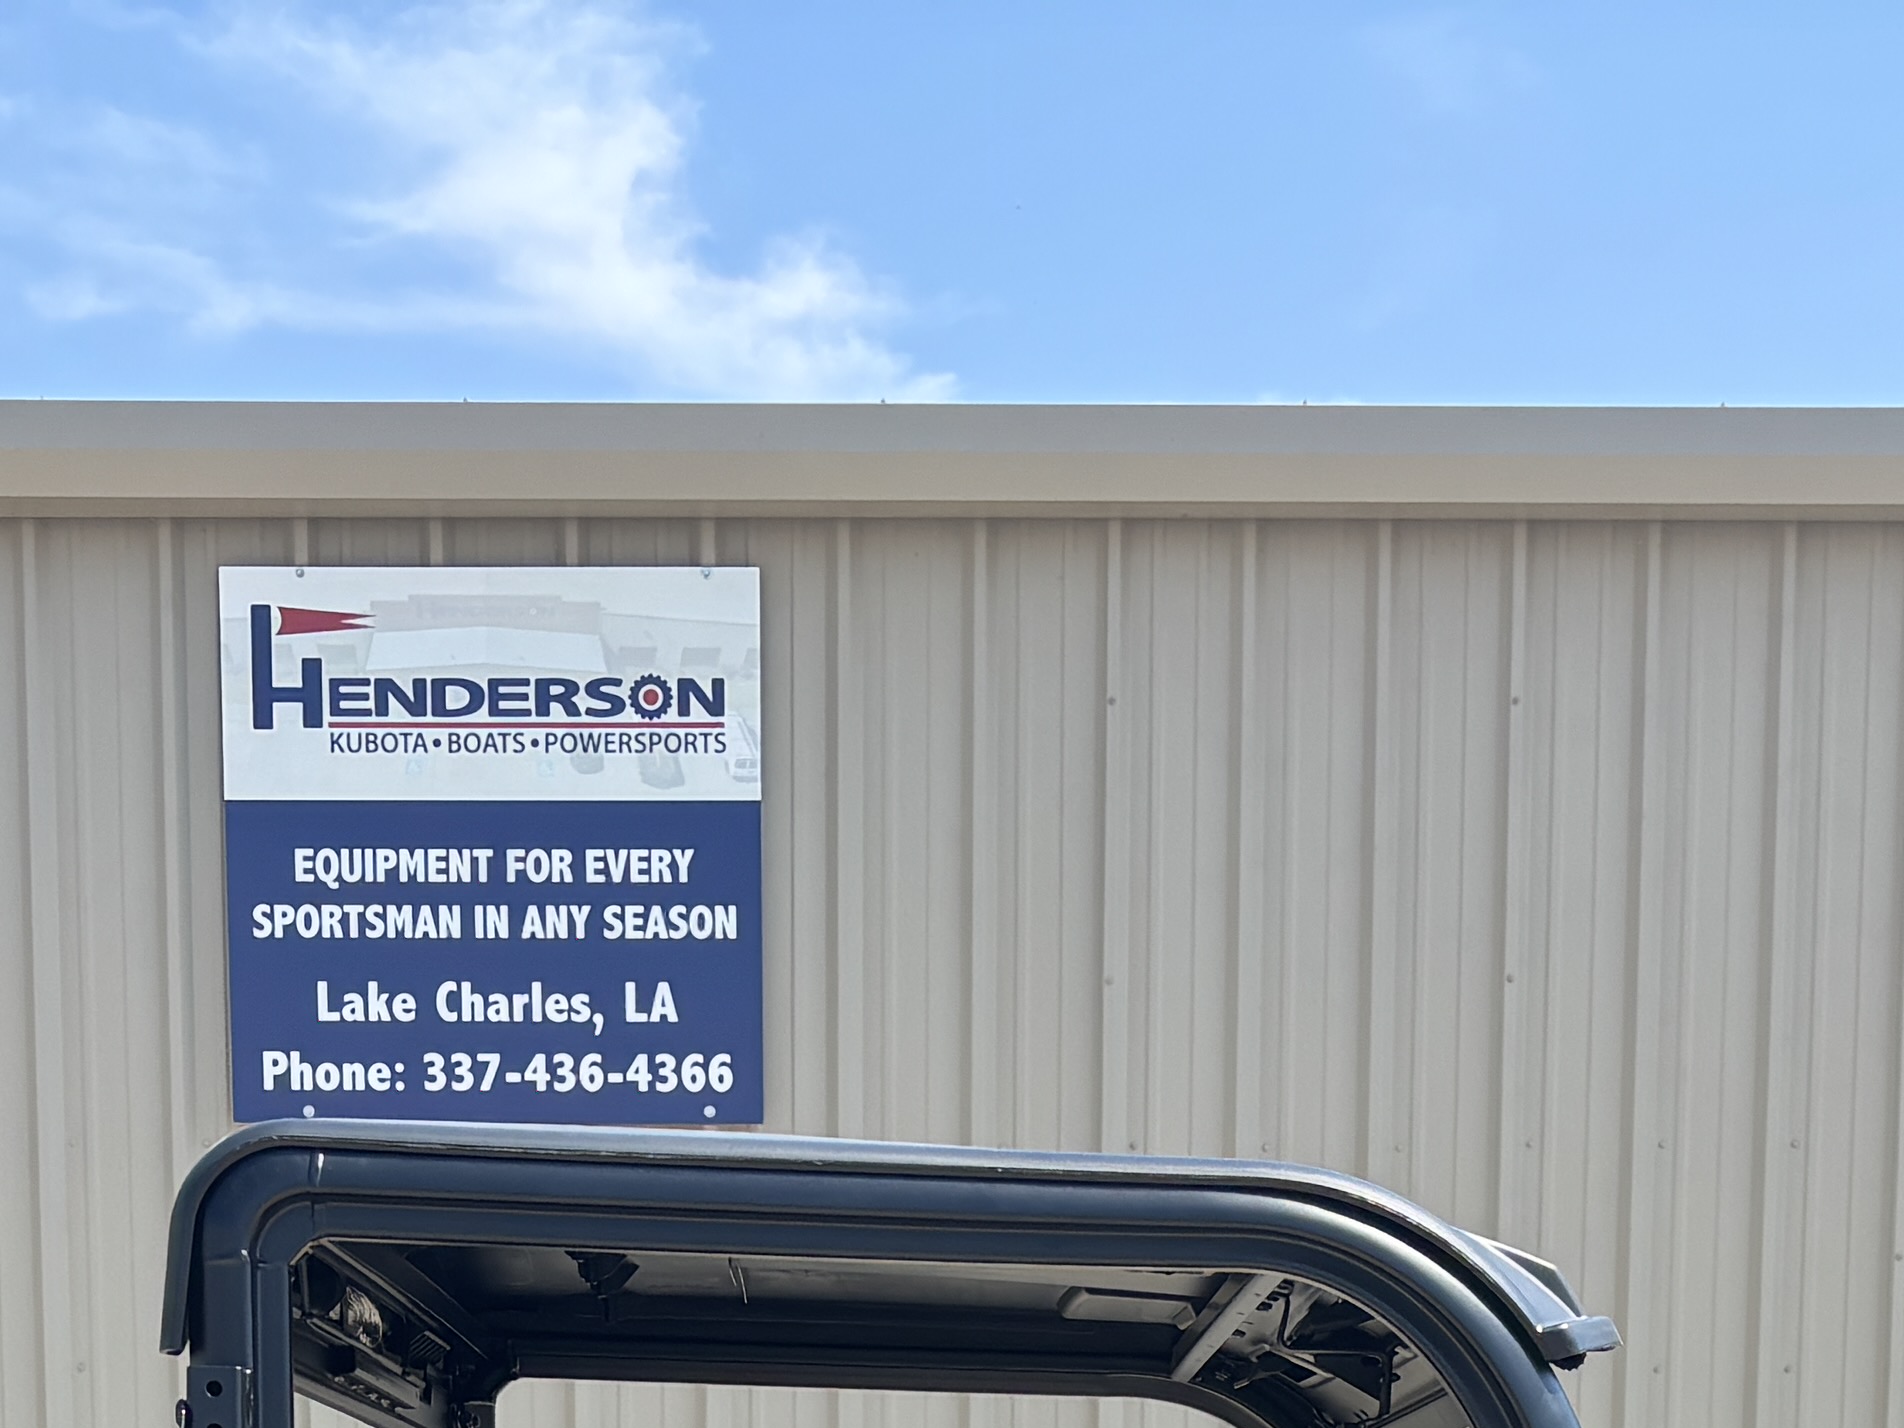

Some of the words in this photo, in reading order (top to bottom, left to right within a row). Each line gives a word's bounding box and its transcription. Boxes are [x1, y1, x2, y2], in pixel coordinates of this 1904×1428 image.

[250, 604, 726, 730] HENDERSON
[329, 732, 428, 754] KUBOTA
[447, 732, 526, 754] BOATS
[545, 732, 727, 754] POWERSPORTS
[294, 847, 494, 890] EQUIPMENT
[506, 848, 574, 883] FOR
[585, 848, 695, 884] EVERY
[252, 903, 462, 939] SPORTSMAN
[474, 904, 509, 939] IN
[521, 904, 592, 940] ANY
[603, 904, 737, 940] SEASON
[316, 980, 417, 1023] Lake
[435, 980, 604, 1036] Charles,
[624, 981, 679, 1023] LA
[262, 1050, 406, 1092] Phone:
[423, 1052, 734, 1093] 337-436-4366
